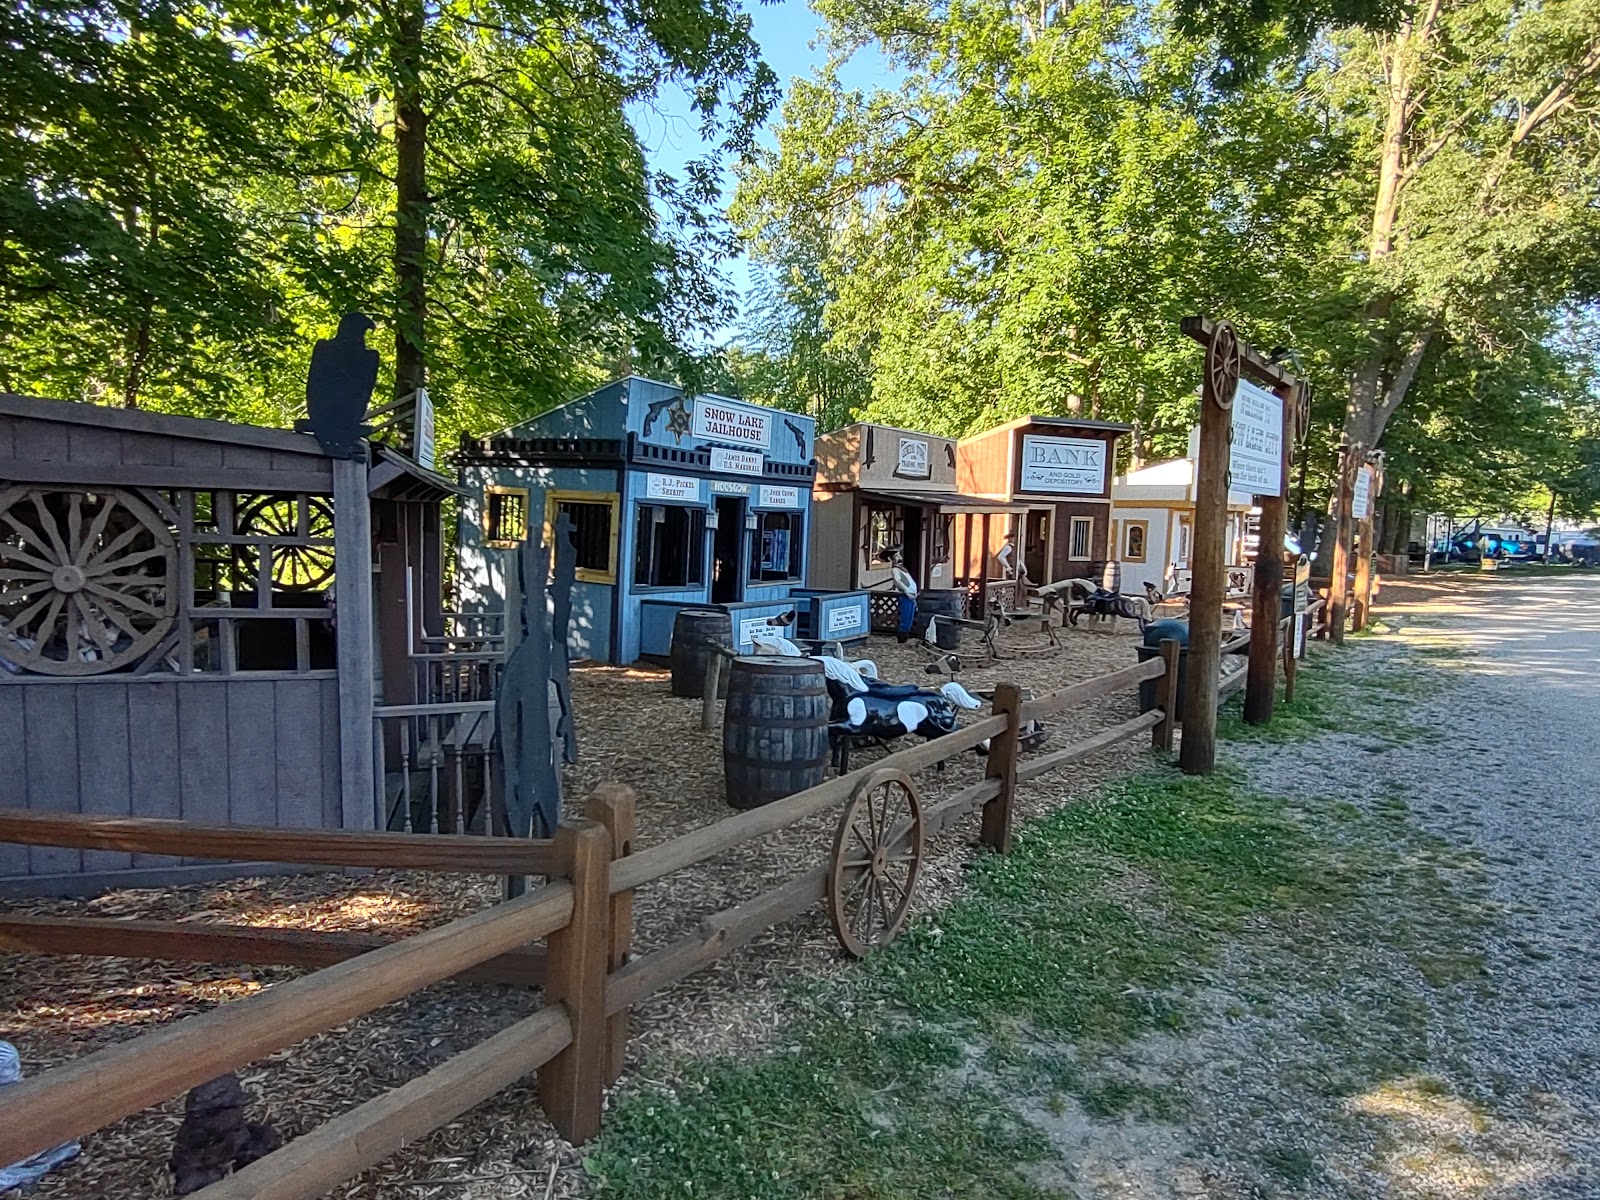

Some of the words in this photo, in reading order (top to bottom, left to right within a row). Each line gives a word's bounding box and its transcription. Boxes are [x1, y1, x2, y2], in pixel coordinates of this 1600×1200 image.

[704, 407, 735, 423] SNOW
[739, 414, 764, 429] LAKE
[705, 421, 761, 441] JAILHOUSE
[1029, 446, 1100, 467] BANK
[1044, 478, 1083, 486] DEPOSITORY
[1048, 471, 1062, 479] AND
